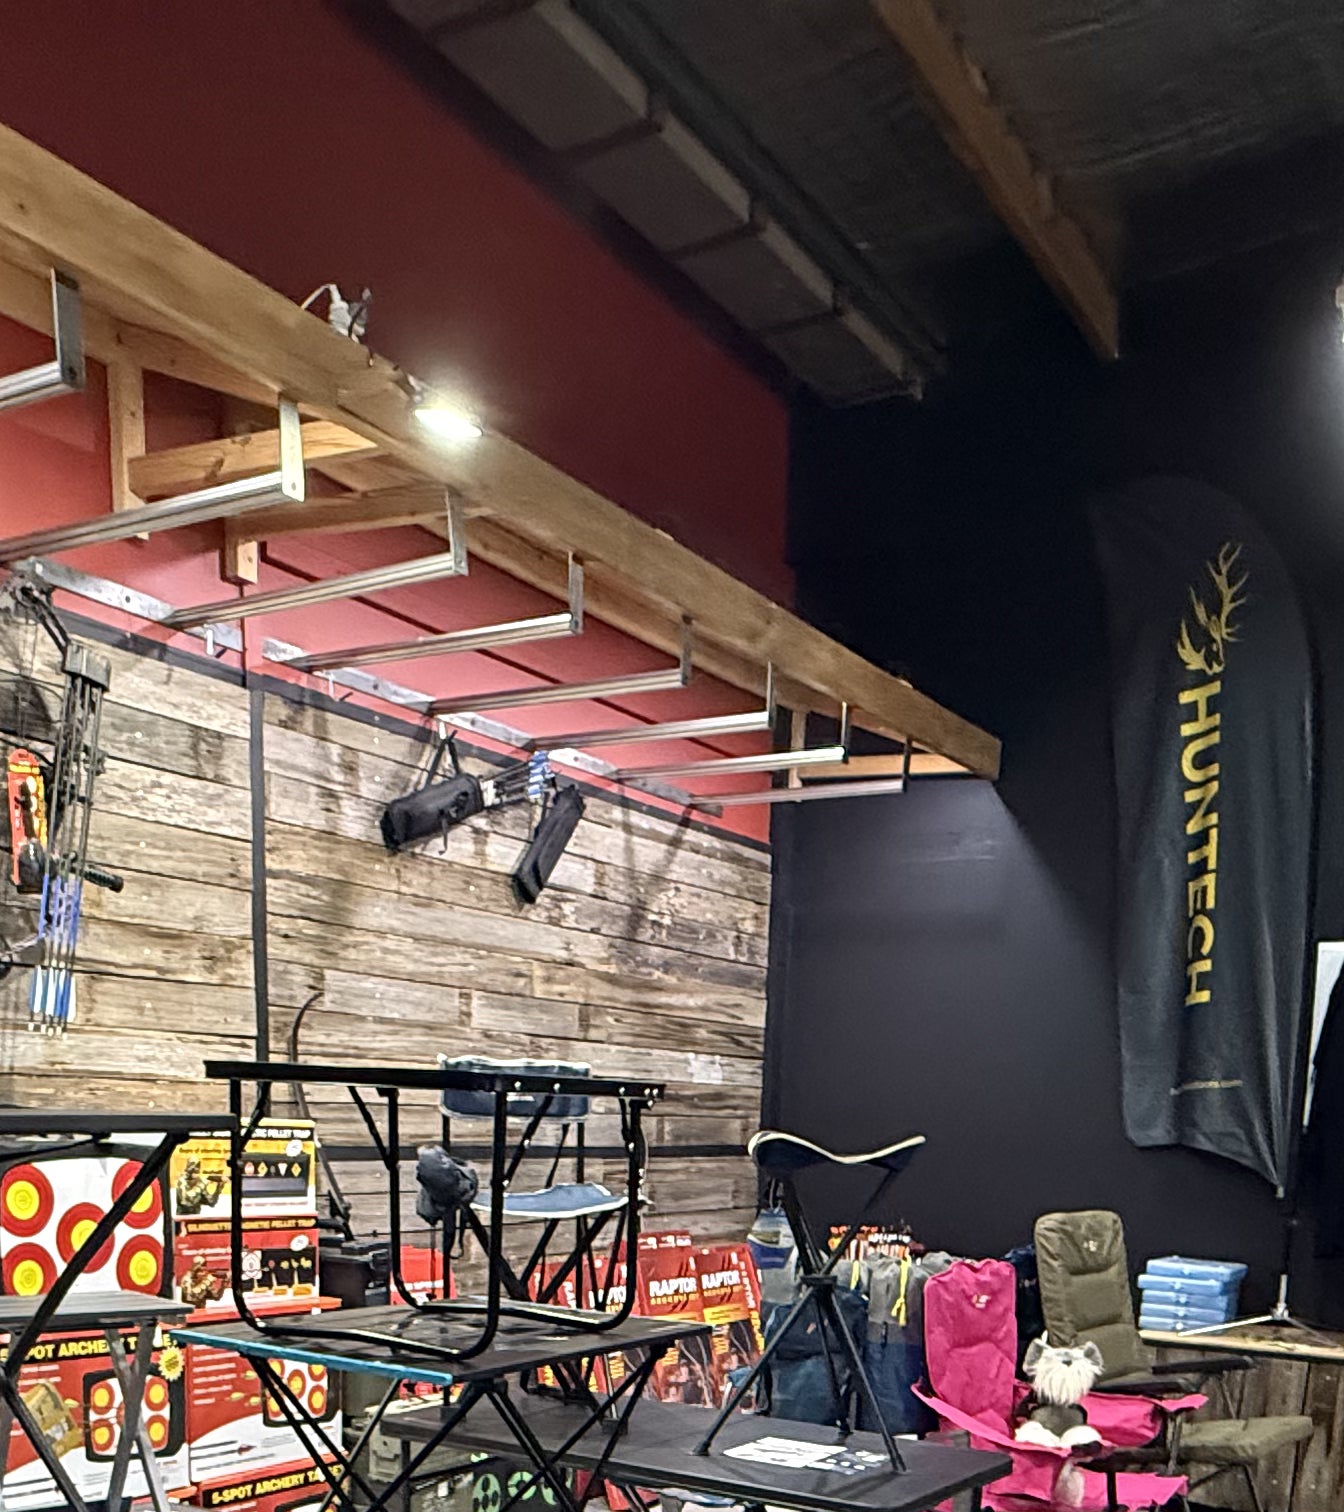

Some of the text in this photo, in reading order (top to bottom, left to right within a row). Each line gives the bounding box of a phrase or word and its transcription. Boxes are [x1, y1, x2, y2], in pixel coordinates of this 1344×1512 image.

[1178, 680, 1223, 1007] HUNTECH
[649, 1277, 696, 1297] RAPTOR
[701, 1270, 740, 1289] RAPTOR
[212, 1482, 253, 1505] 5-SPOT
[255, 1470, 306, 1497] ARCHERY
